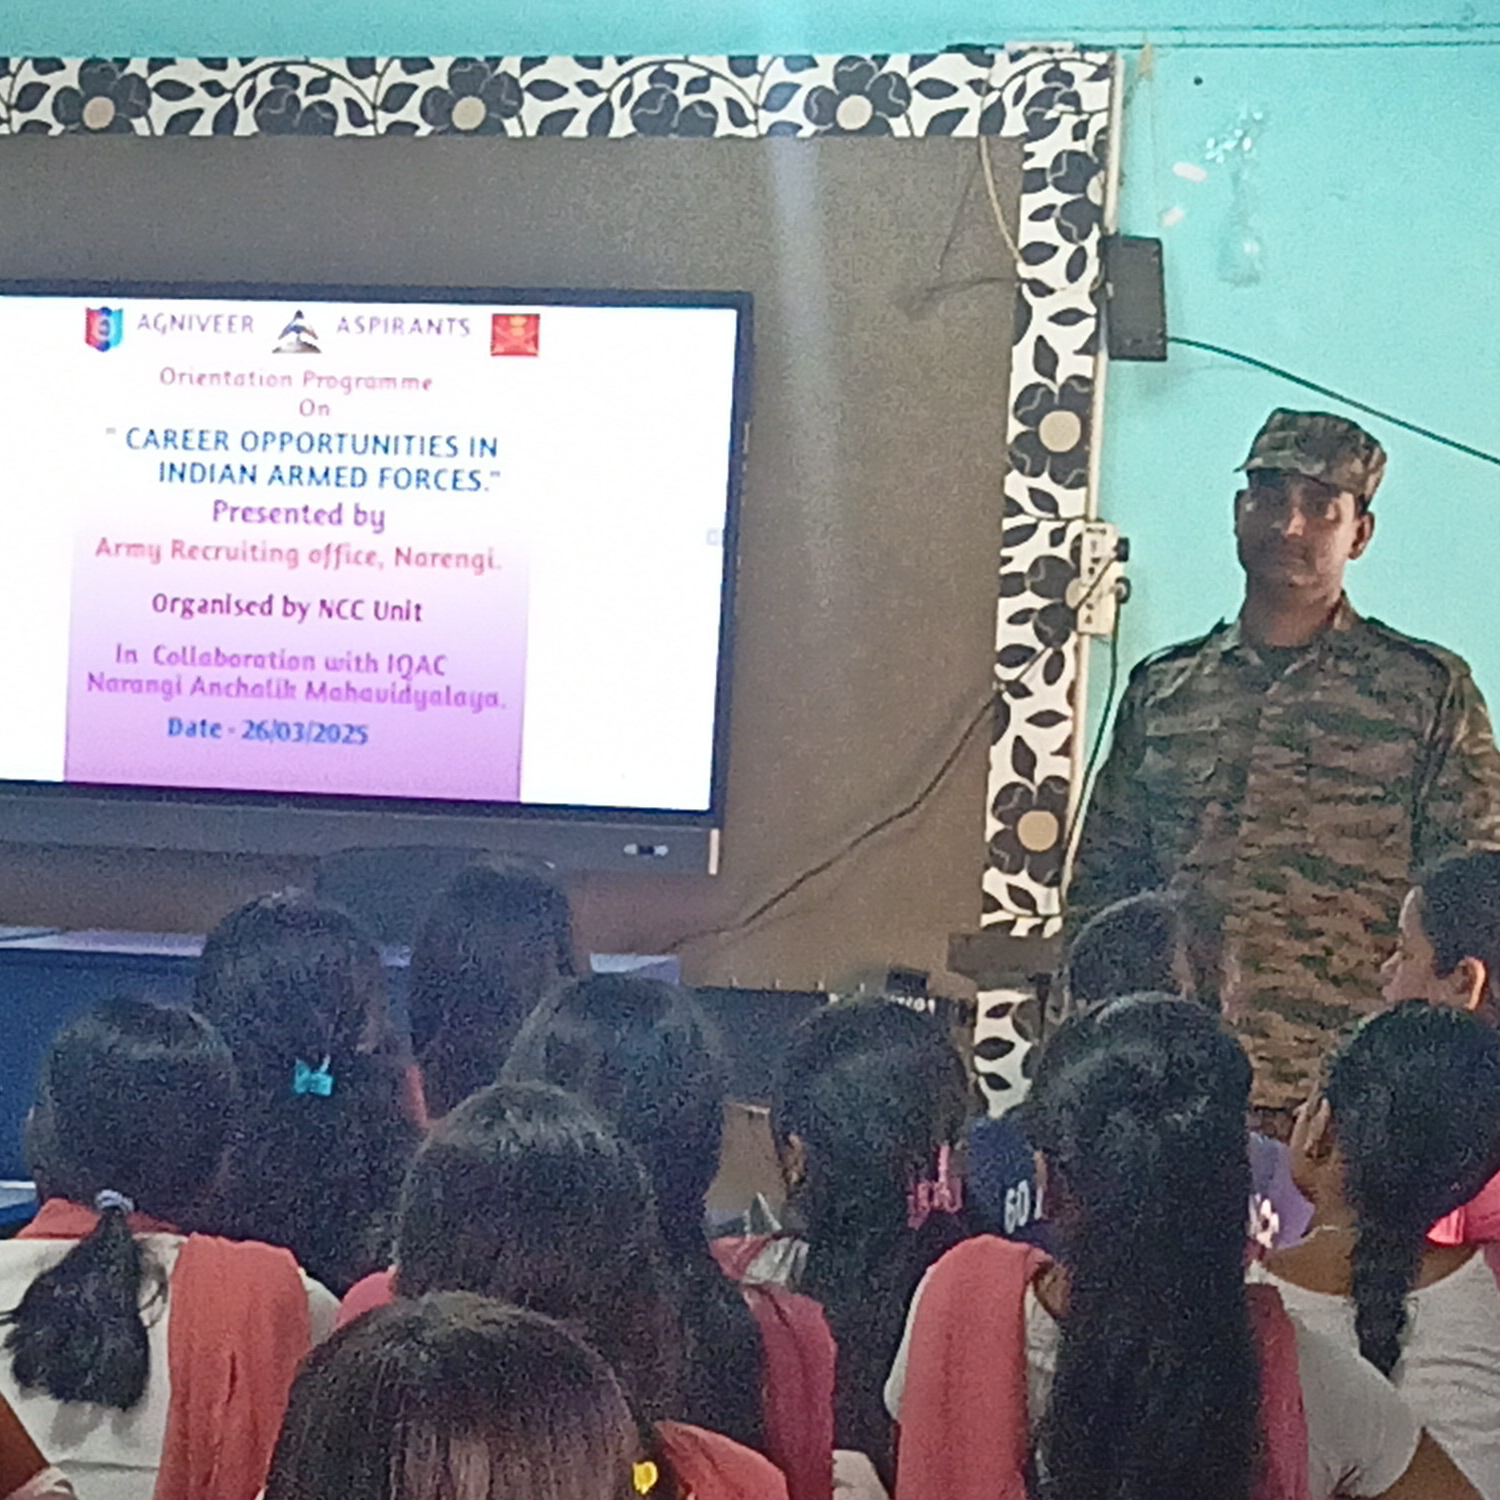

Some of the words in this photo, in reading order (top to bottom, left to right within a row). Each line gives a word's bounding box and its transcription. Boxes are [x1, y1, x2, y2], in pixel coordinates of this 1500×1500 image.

[137, 313, 254, 335] AGNIVEER
[336, 316, 470, 336] ASPIRANTS
[160, 367, 292, 388] Orientation
[303, 370, 432, 395] Programme
[299, 399, 330, 417] On
[125, 427, 229, 451] CAREER
[241, 430, 458, 457] OPPORTUNITIES
[470, 436, 497, 458] IN
[159, 462, 256, 485] INDIAN
[268, 464, 367, 488] ARMED
[212, 500, 342, 527] Presented
[354, 503, 385, 533] by
[95, 537, 161, 564] Army
[171, 539, 299, 568] Recruiting
[308, 542, 384, 571] office,
[395, 546, 502, 575] Narengi.
[152, 593, 273, 620] Organised
[282, 596, 310, 623] by
[318, 599, 364, 621] NCC
[374, 600, 423, 622] Unit
[115, 644, 138, 664] In
[153, 644, 316, 671] Collaboration
[325, 651, 379, 673] with
[387, 653, 447, 680] IQAC
[87, 672, 183, 701] Narangi
[190, 676, 296, 700] Anchalik
[305, 681, 506, 712] Mahavidyalaya.
[167, 717, 222, 738] Date
[241, 719, 369, 745] 26/03/2025
